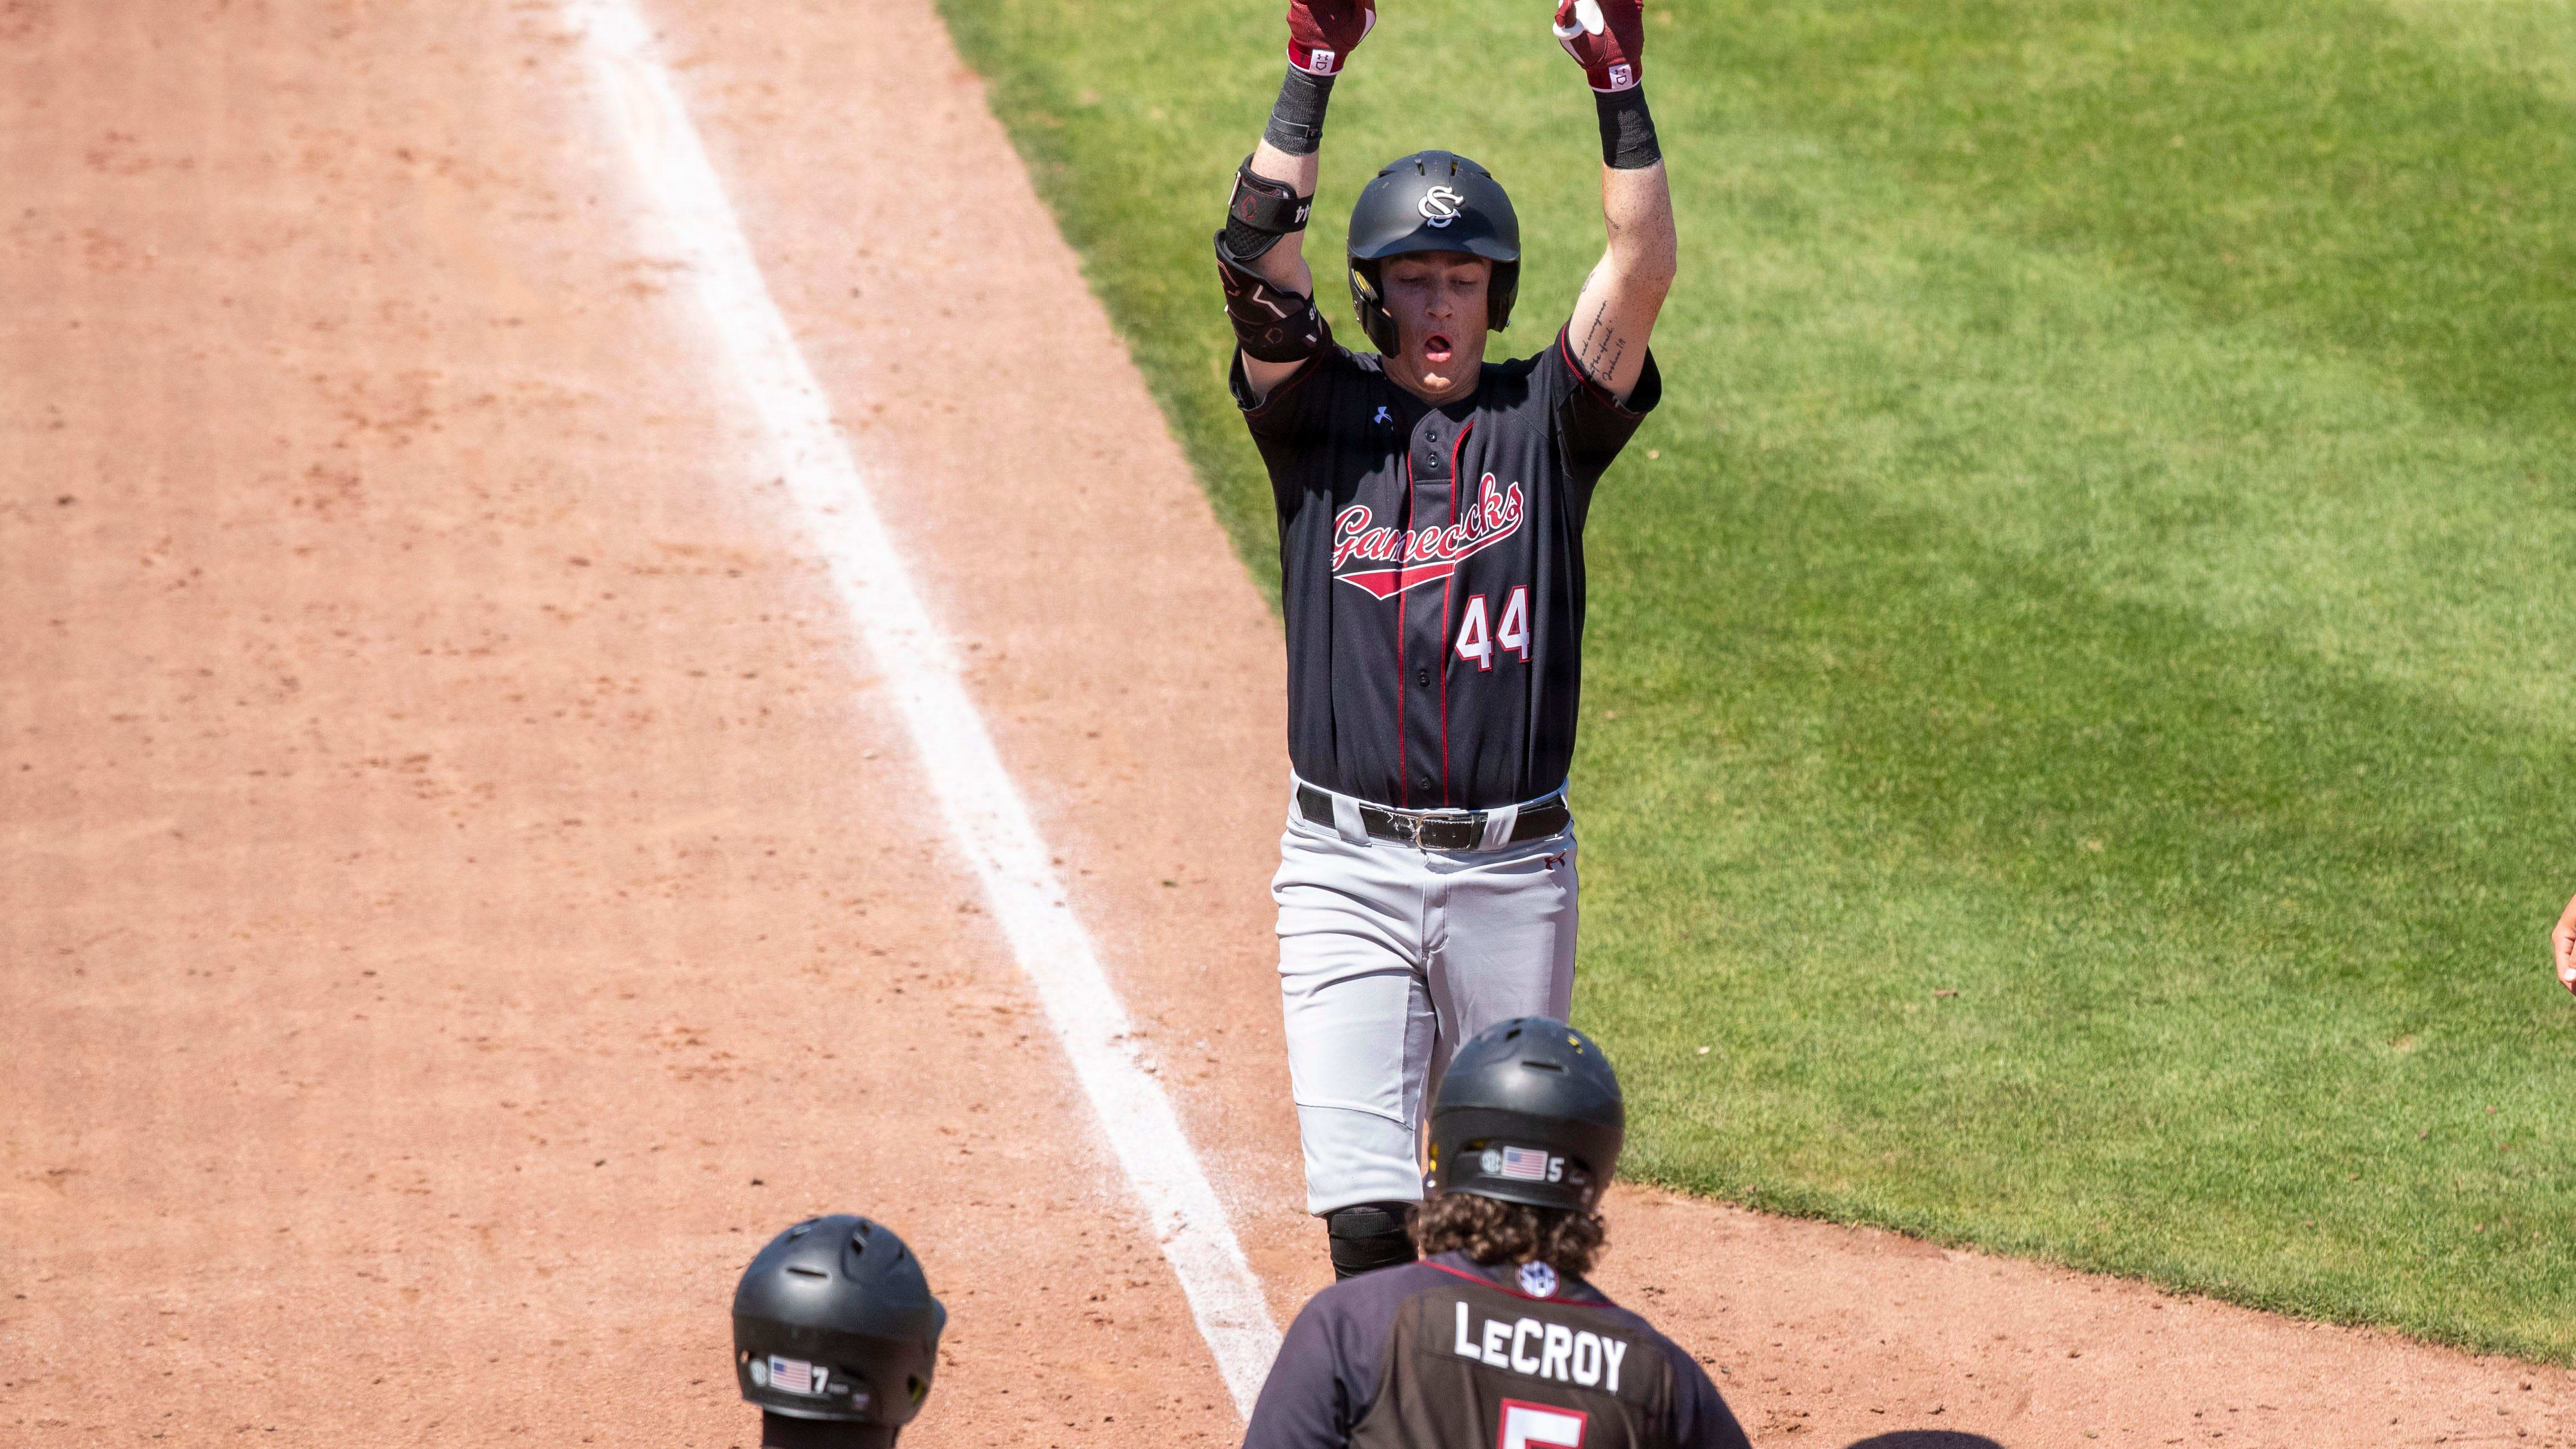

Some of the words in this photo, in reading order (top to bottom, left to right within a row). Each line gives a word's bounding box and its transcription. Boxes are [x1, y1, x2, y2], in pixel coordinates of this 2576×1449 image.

[1602, 350, 1621, 381] Joshua
[1330, 472, 1524, 572] Gameccks
[1454, 584, 1533, 672] 44
[1546, 1157, 1565, 1183] 5
[811, 1366, 829, 1394] 7
